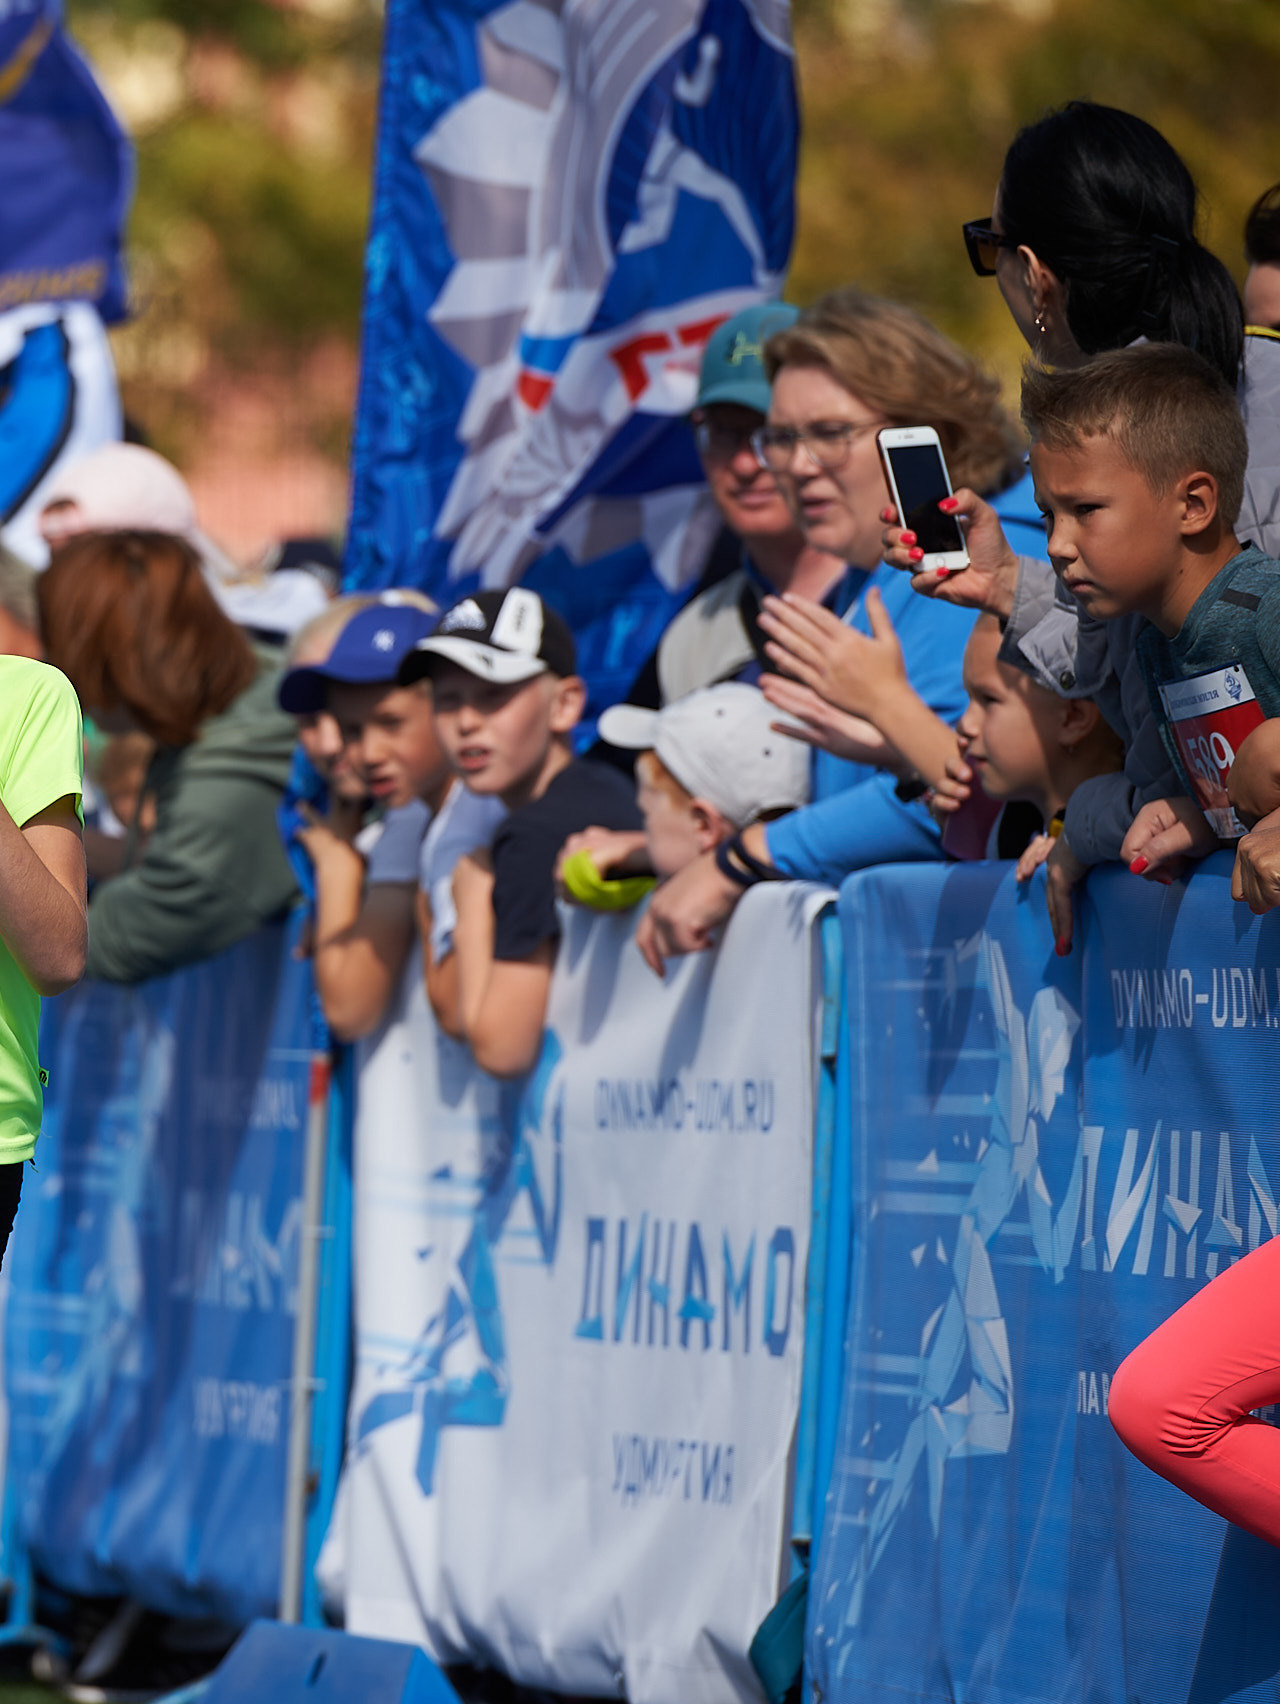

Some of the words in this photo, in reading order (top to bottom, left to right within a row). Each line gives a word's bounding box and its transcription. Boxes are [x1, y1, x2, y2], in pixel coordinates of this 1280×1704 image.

[1110, 968, 1280, 1028] DYNAMO-UDM.
[595, 1078, 775, 1134] DYNAMO-UDM.RU
[574, 1210, 796, 1357] ДИНАМО
[612, 1431, 736, 1506] УДМУРТИЯ
